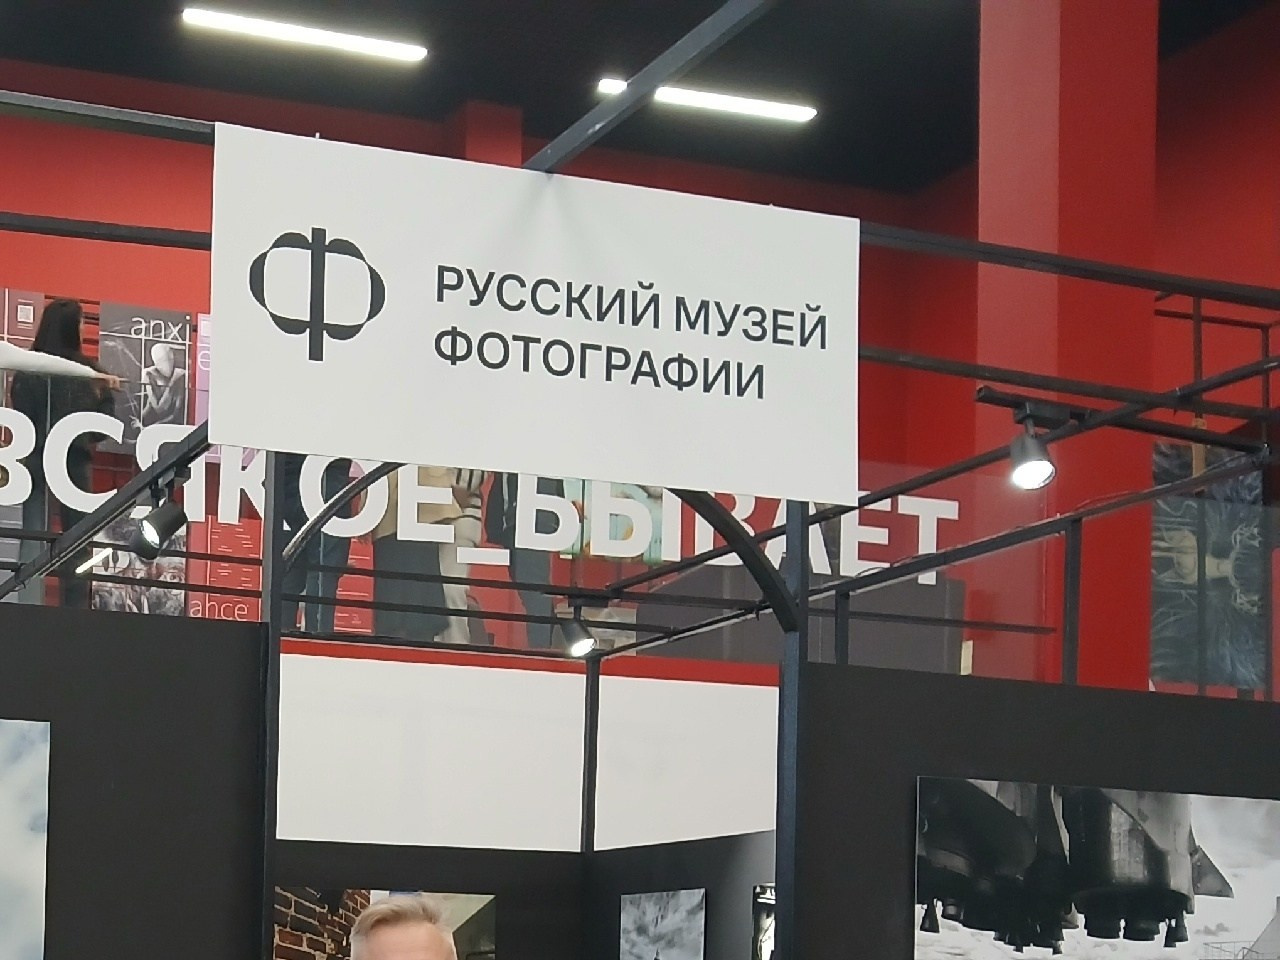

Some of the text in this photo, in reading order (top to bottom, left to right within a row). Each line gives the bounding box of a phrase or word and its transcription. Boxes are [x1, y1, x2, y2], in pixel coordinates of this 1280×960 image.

[131, 315, 192, 343] anxi
[436, 264, 828, 350] РУССКИЙ МУЗЕЙ
[434, 325, 766, 400] ФОТОГРАФИИ
